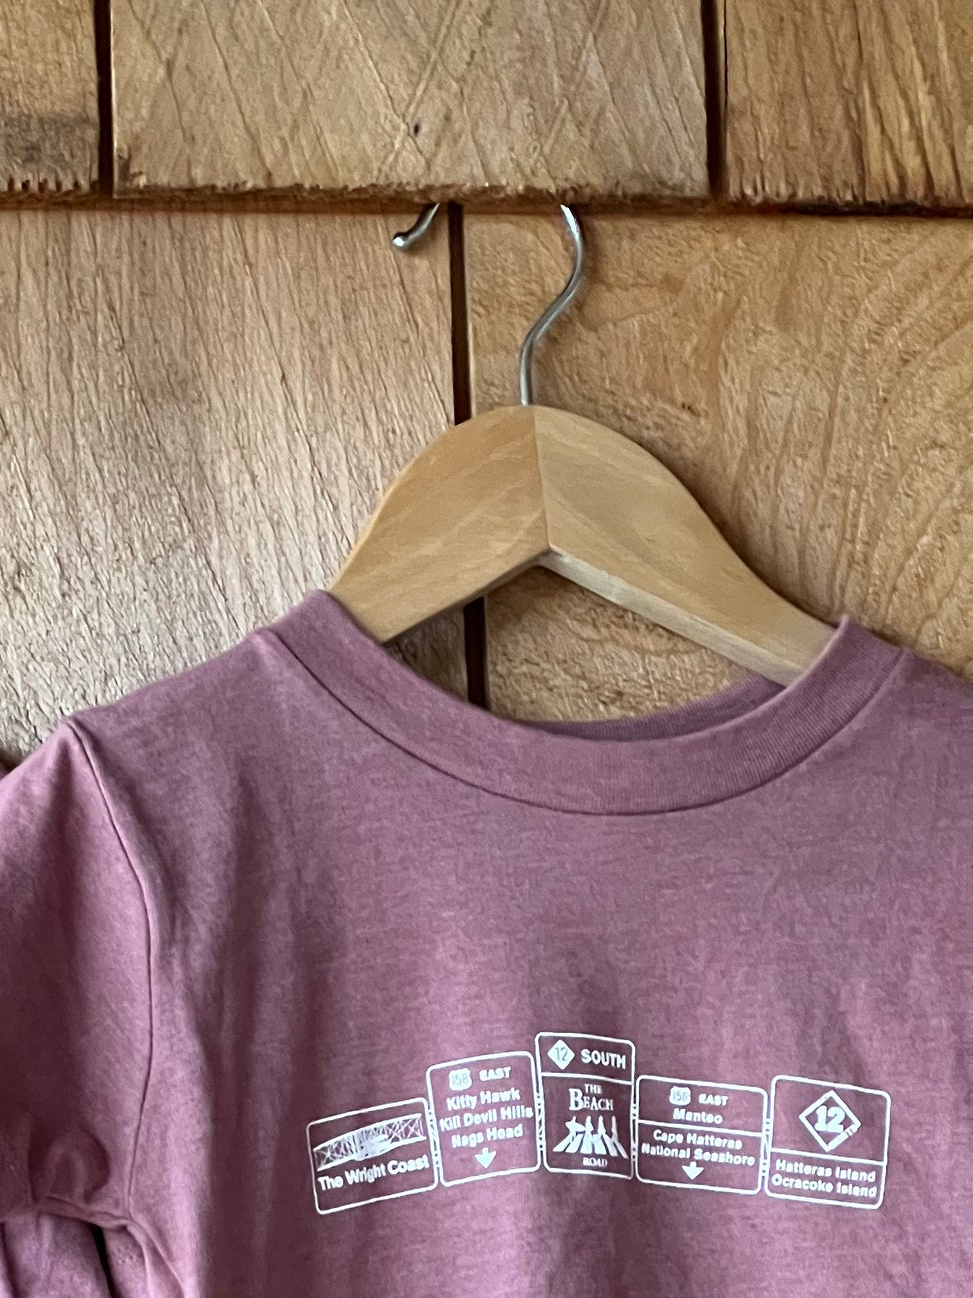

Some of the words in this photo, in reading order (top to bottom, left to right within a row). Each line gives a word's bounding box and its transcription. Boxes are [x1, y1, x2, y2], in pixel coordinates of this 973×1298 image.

[555, 1046, 569, 1062] 12
[580, 1048, 626, 1070] SOUTH
[451, 1073, 469, 1086] 158
[479, 1066, 512, 1082] EAST
[446, 1094, 477, 1111] Kitty
[480, 1086, 521, 1104] Hawk
[568, 1088, 614, 1111] BEACH
[584, 1083, 602, 1094] THE
[698, 1093, 729, 1106] EAST
[439, 1115, 461, 1132] Kill
[463, 1108, 497, 1127] Devil
[500, 1105, 534, 1120] Hills
[673, 1108, 723, 1124] Manteo
[814, 1105, 846, 1134] 12
[451, 1131, 485, 1148] Nags
[486, 1123, 523, 1141] Head
[653, 1129, 684, 1144] Cape
[686, 1132, 743, 1150] Hatteras
[582, 1157, 608, 1168] ROAD
[641, 1142, 691, 1159] National
[693, 1148, 755, 1167] Seashore
[317, 1176, 344, 1191] The
[345, 1163, 386, 1185] Wright
[387, 1154, 430, 1175] Coast
[775, 1159, 832, 1177] Hatteras
[835, 1166, 876, 1182] Island
[771, 1173, 834, 1193] Ocracoke
[836, 1181, 878, 1198] Island
